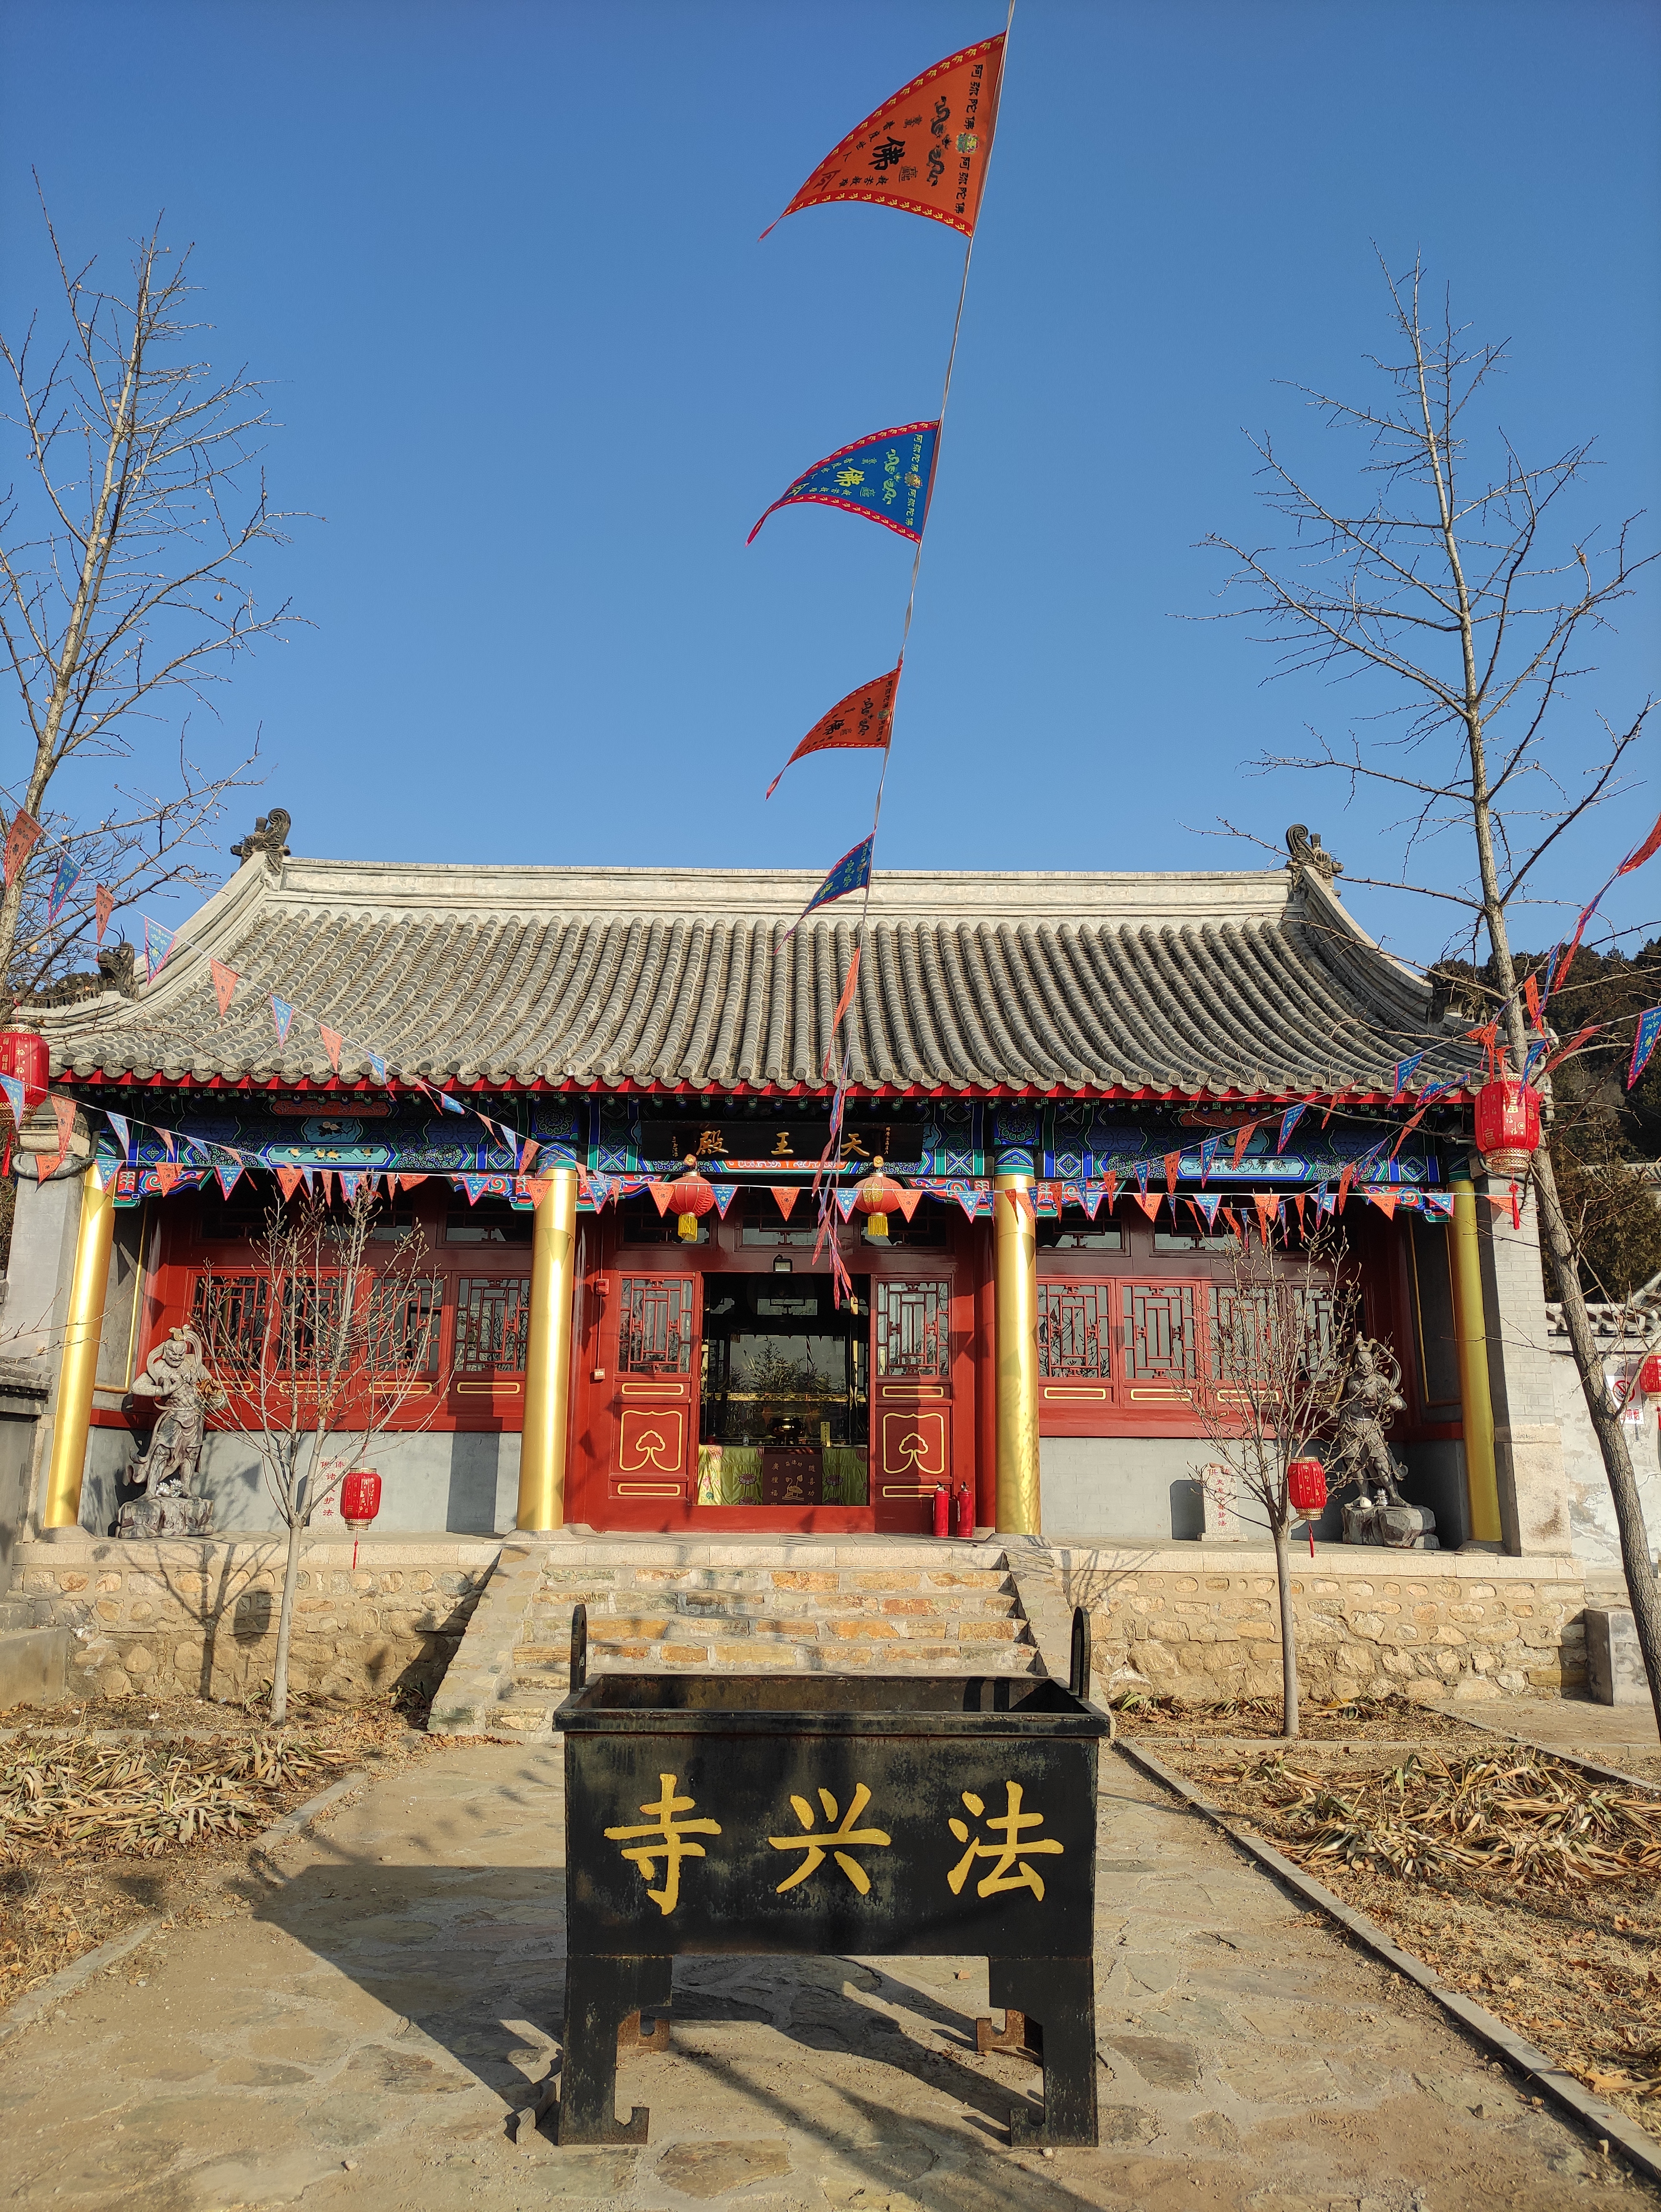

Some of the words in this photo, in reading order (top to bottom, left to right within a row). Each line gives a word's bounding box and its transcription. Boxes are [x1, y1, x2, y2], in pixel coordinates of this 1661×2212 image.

[964, 64, 983, 130] 阿弥陀佛
[842, 120, 894, 163] 普度世人
[869, 136, 905, 171] 佛
[954, 156, 970, 214] 阿弥陀佛
[909, 433, 923, 473] 阿弥陀佛
[833, 466, 865, 487] 佛
[905, 488, 917, 526] 阿弥陀佛
[696, 1129, 870, 1157] 天王殿
[603, 1773, 1064, 1916] 法兴寺
